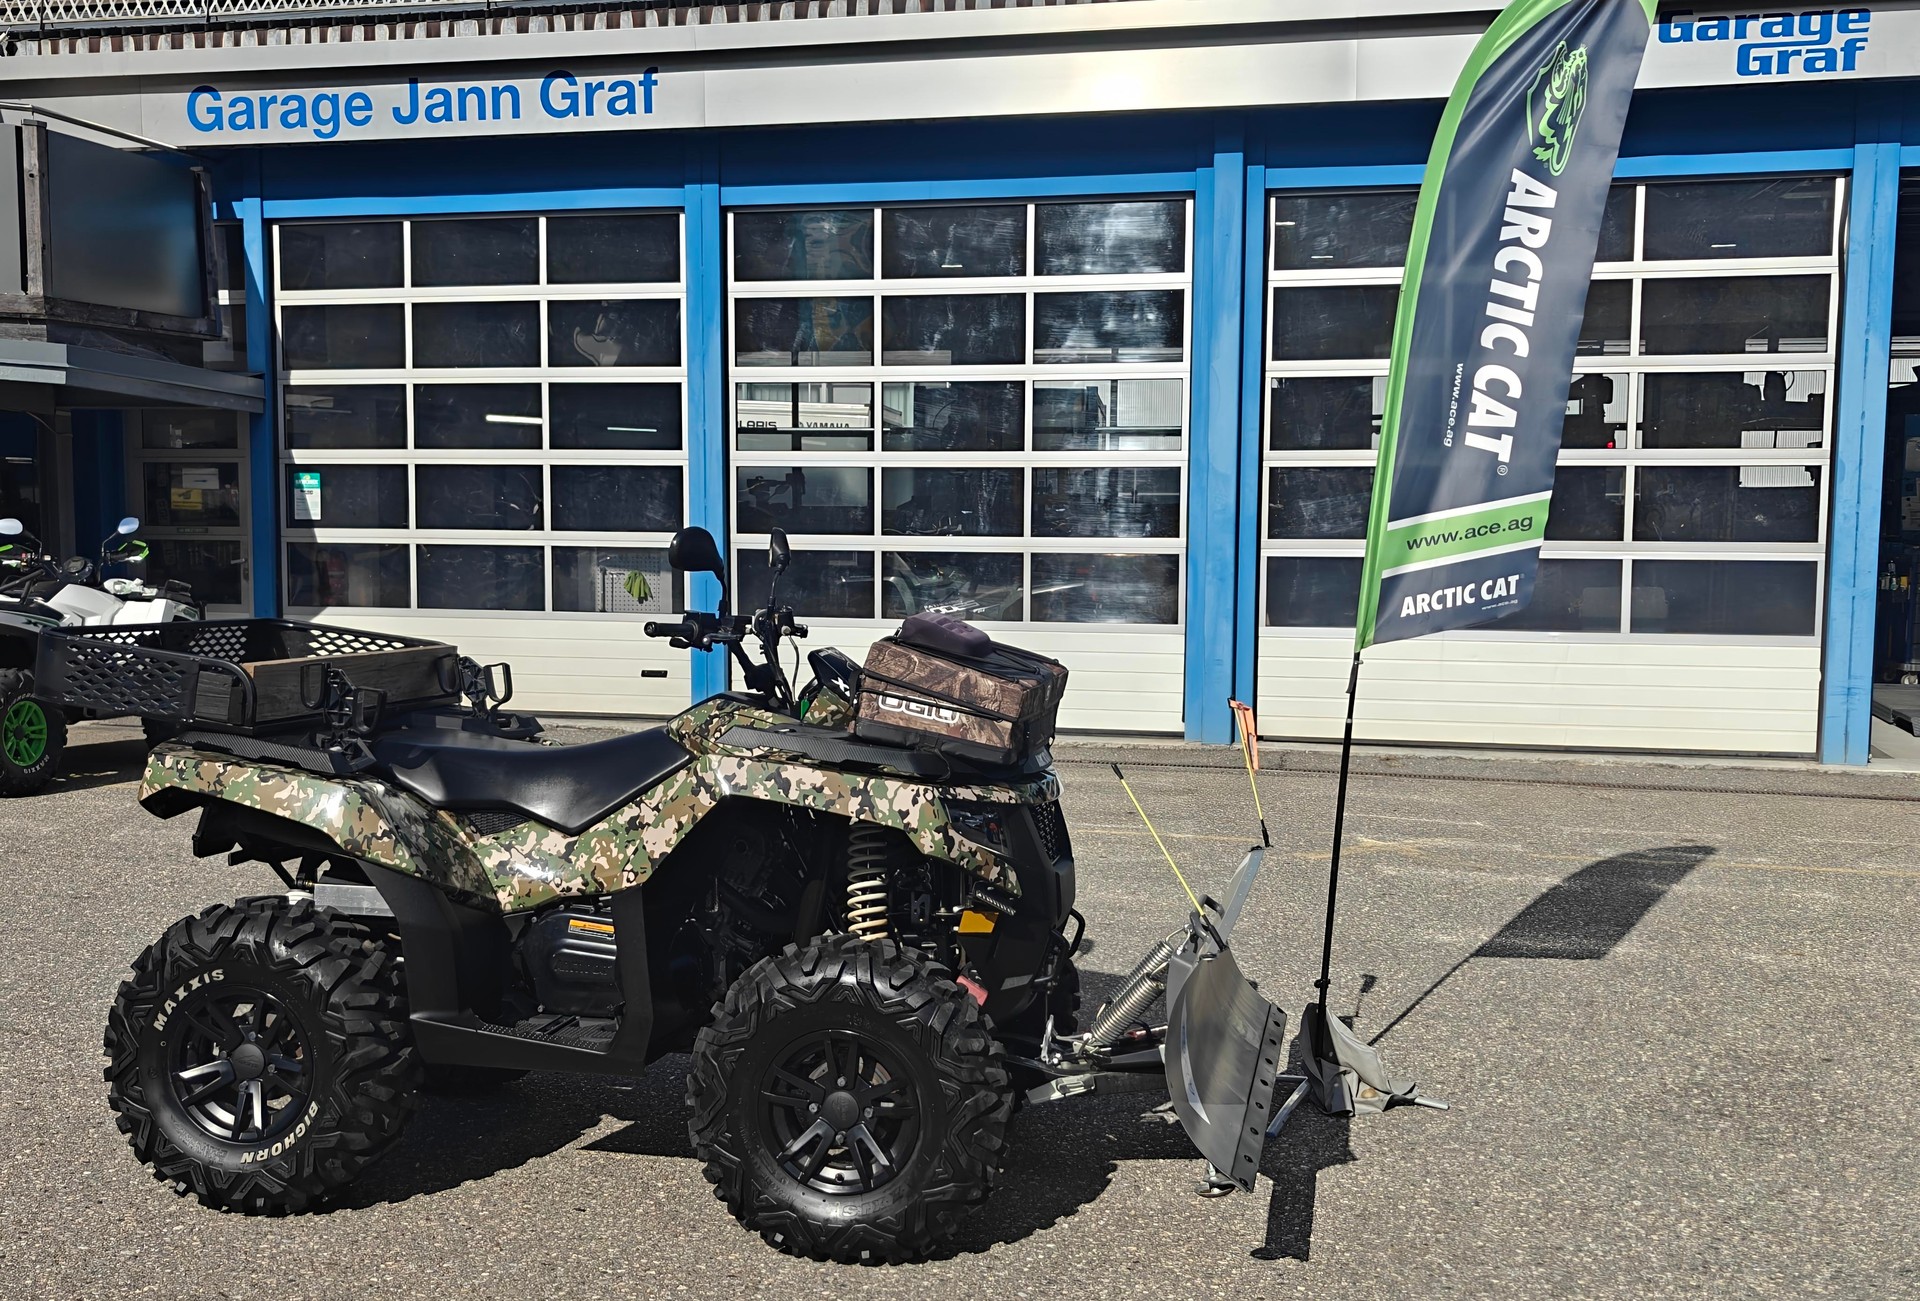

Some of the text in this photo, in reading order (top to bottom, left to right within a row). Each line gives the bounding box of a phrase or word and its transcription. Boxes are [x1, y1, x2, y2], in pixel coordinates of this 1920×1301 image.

[1658, 8, 1871, 47] Garage
[1736, 37, 1869, 77] Graf
[186, 67, 659, 140] Garage Jann Graf
[1480, 167, 1558, 358] ARCTIC
[1443, 362, 1464, 447] www.ace.ag
[1406, 516, 1533, 551] www.ace.ag
[1400, 583, 1475, 618] ARCTIC
[152, 968, 225, 1032] MAXXIS
[240, 1100, 319, 1165] BIGHORN
